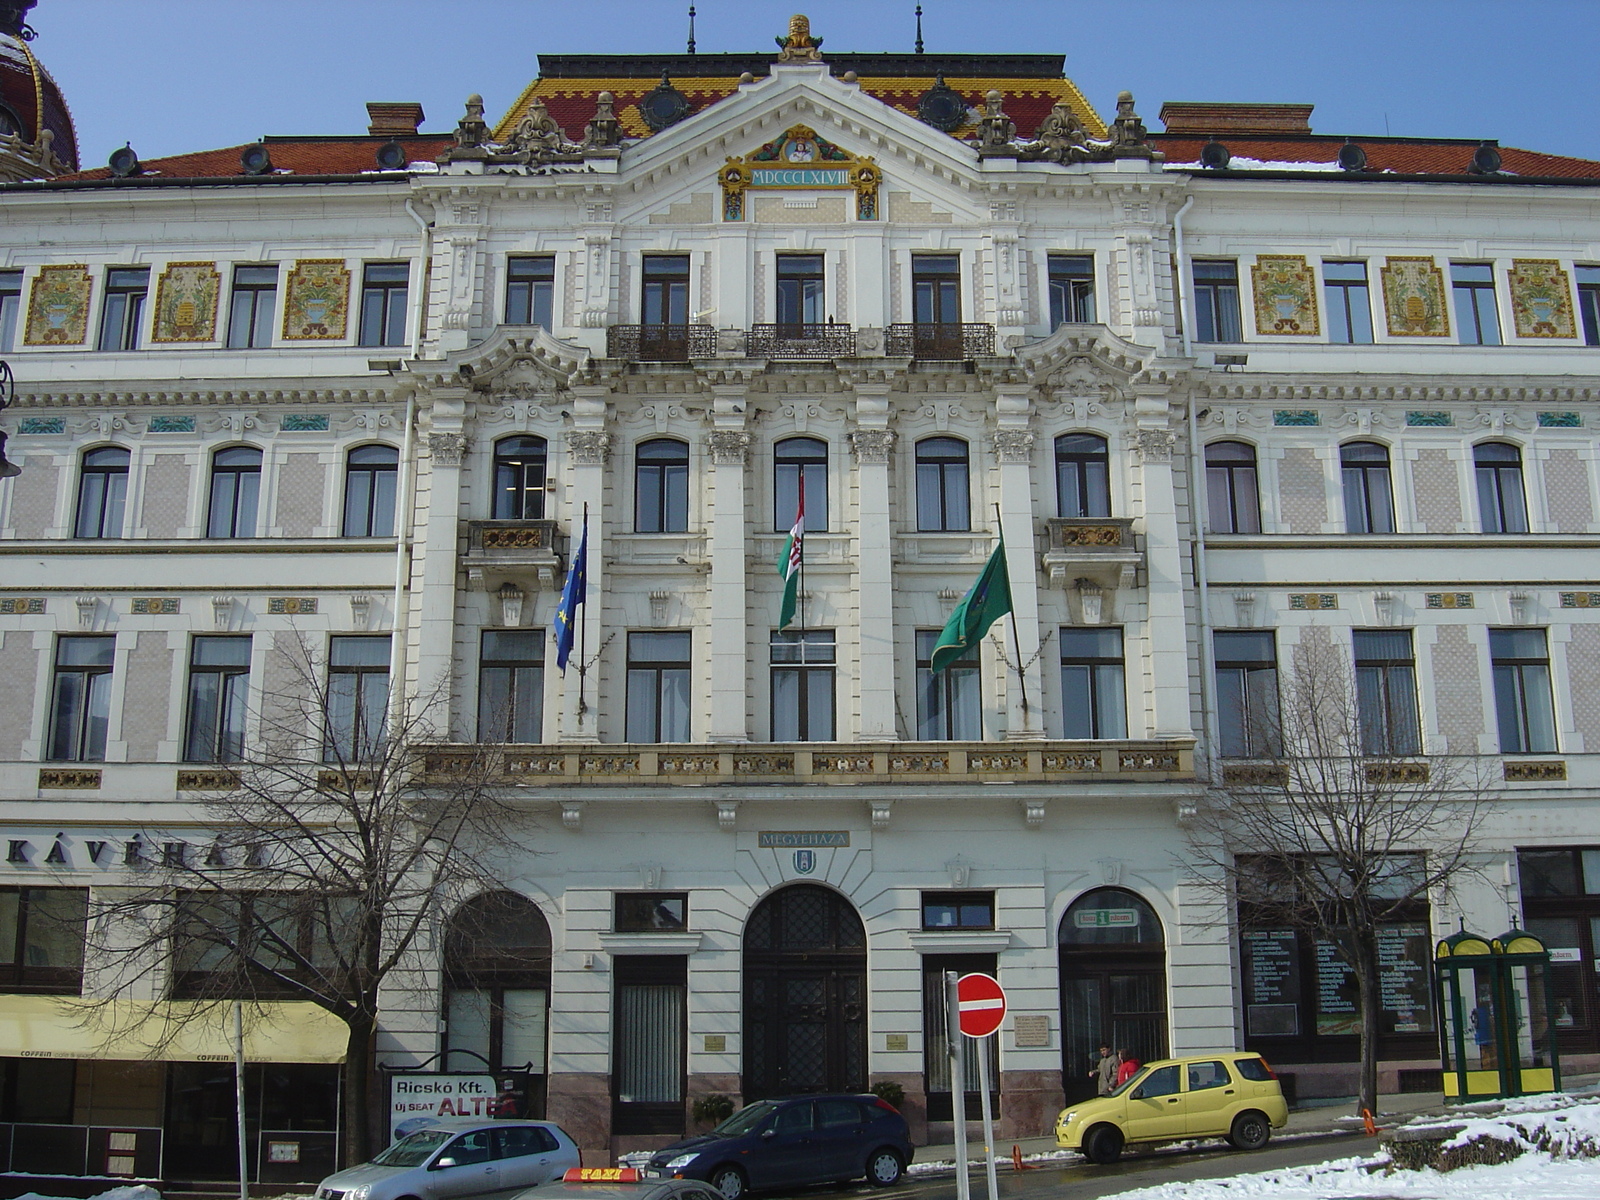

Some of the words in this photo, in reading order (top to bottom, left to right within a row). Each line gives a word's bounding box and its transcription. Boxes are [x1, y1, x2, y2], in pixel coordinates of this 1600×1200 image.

[762, 833, 847, 845] MEGYEHÁZA
[6, 831, 264, 866] KÁVÉHÁZ
[396, 1081, 453, 1094] Ricskó
[458, 1082, 487, 1094] Kft.
[408, 1103, 435, 1111] SEAT
[437, 1096, 517, 1117] ALTEA
[580, 1168, 623, 1180] TAXI
